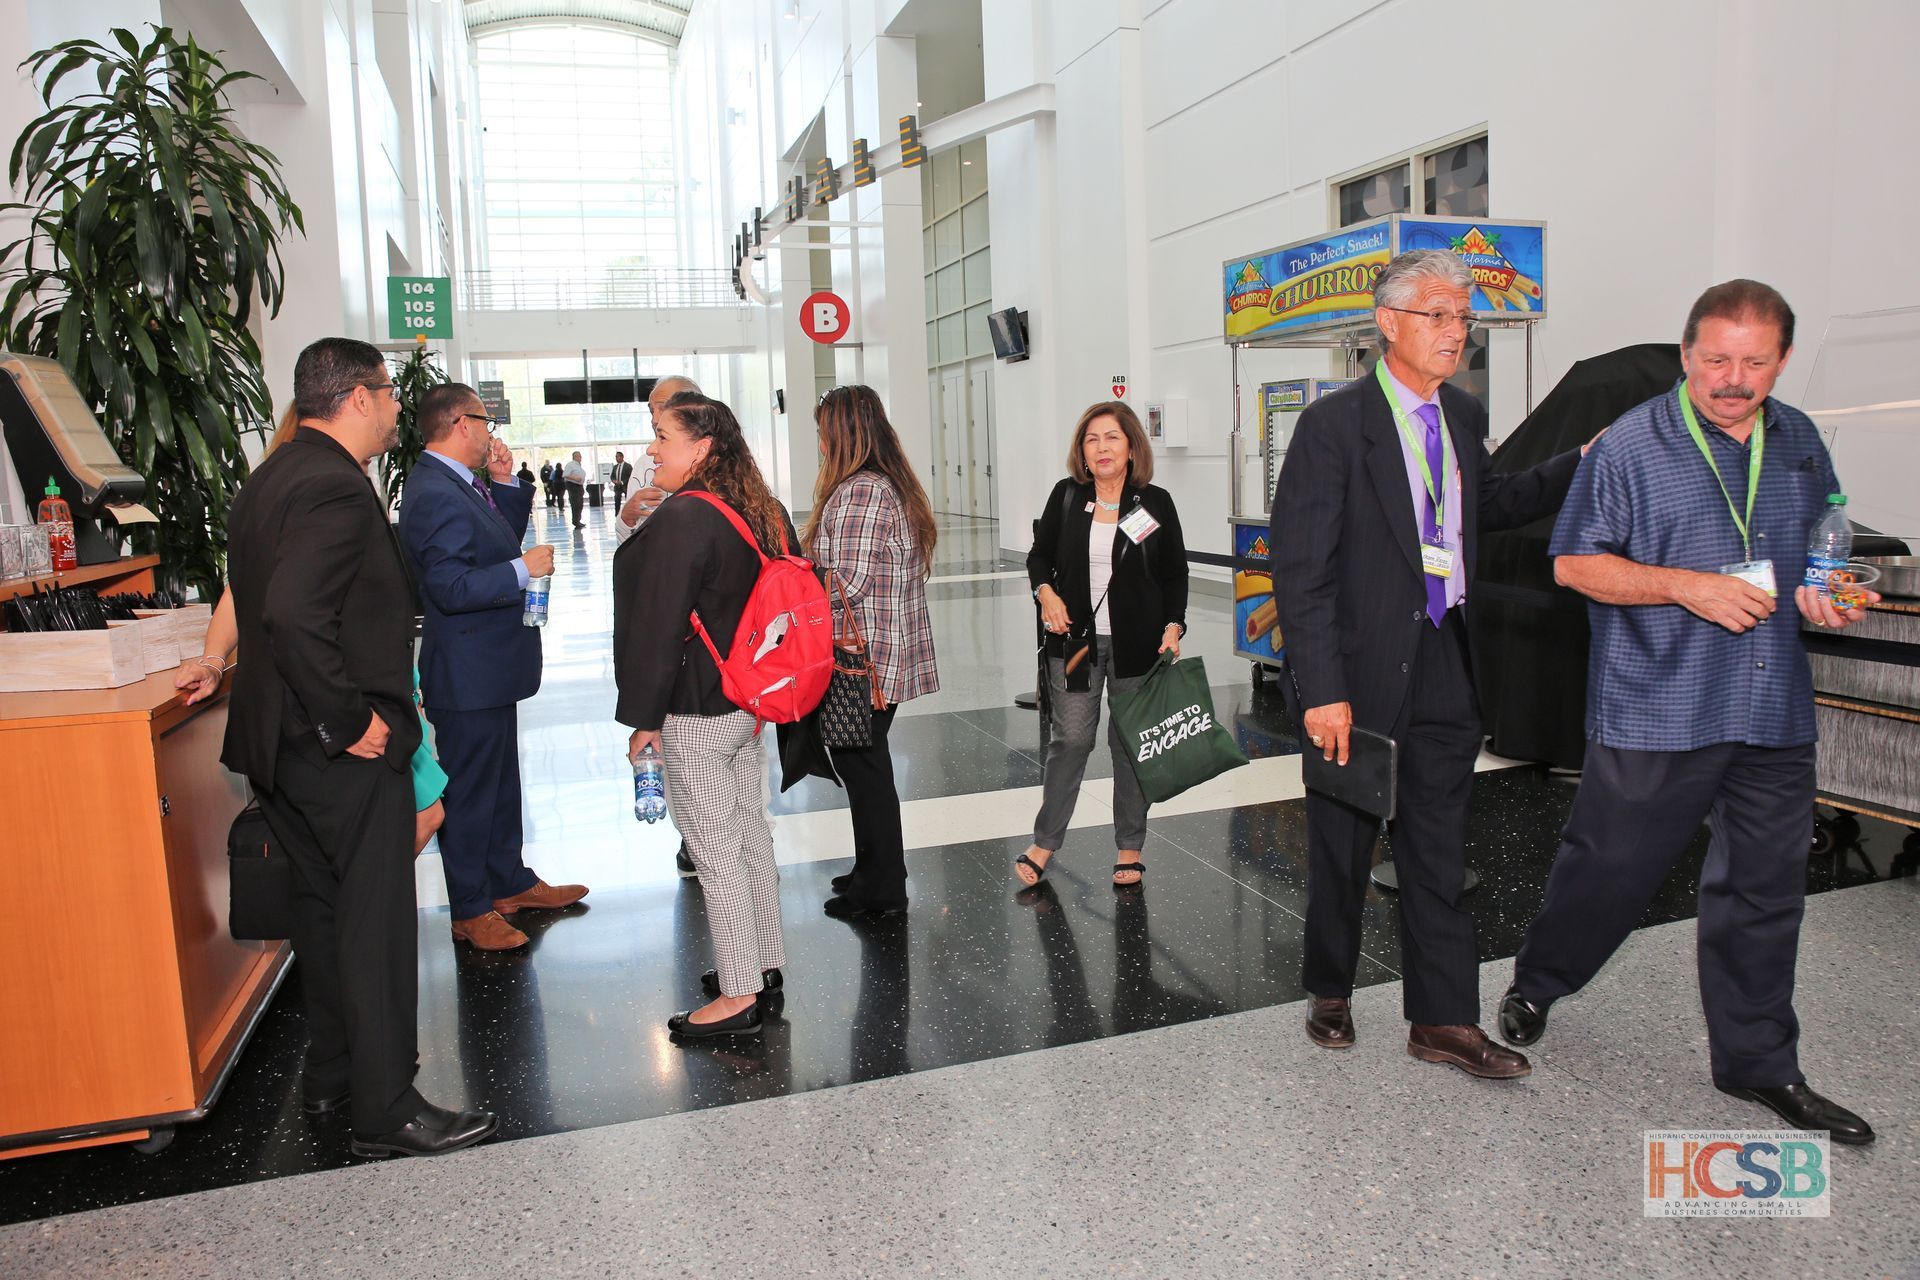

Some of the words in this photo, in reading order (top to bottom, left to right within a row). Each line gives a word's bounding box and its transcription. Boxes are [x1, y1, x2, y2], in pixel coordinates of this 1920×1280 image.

[1290, 259, 1308, 273] The
[1310, 244, 1345, 266] Perfect
[1347, 232, 1384, 253] Snack!
[1472, 268, 1508, 287] RROS
[403, 282, 436, 295] 104
[1270, 264, 1383, 315] CHURROS
[404, 301, 436, 313] 105
[1233, 292, 1267, 310] CHURROS
[405, 316, 436, 329] 106
[813, 302, 840, 333] B
[1112, 375, 1126, 383] AED
[1139, 725, 1161, 742] IT'S
[1160, 711, 1186, 731] TIME
[1184, 704, 1201, 717] TO
[1137, 712, 1213, 763] ENGAGE
[637, 779, 664, 791] 100%
